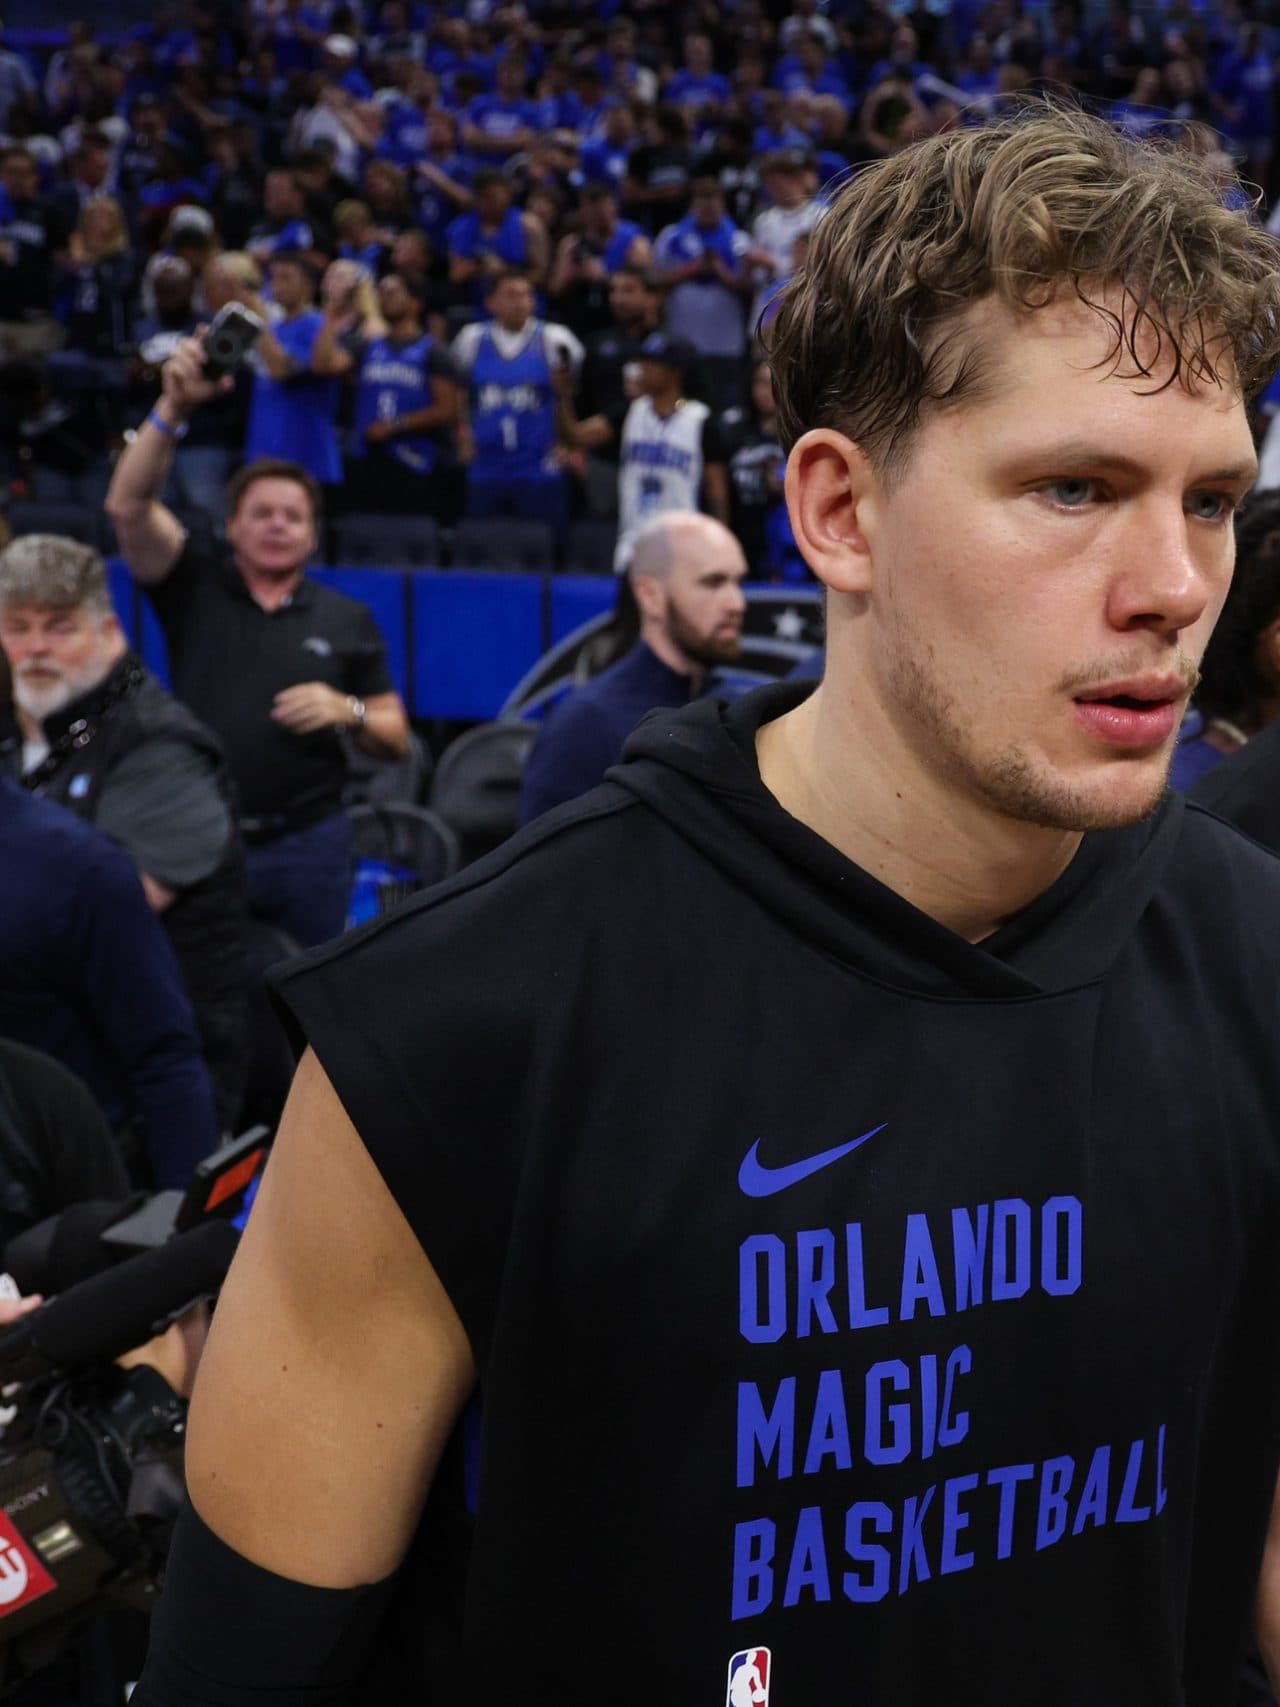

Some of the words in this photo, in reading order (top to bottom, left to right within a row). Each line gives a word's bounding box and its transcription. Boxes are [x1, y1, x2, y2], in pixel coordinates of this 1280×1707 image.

[739, 1195, 1083, 1344] ORLANDO
[736, 1344, 972, 1487] MAGIC
[731, 1424, 1167, 1620] BASKETBALL
